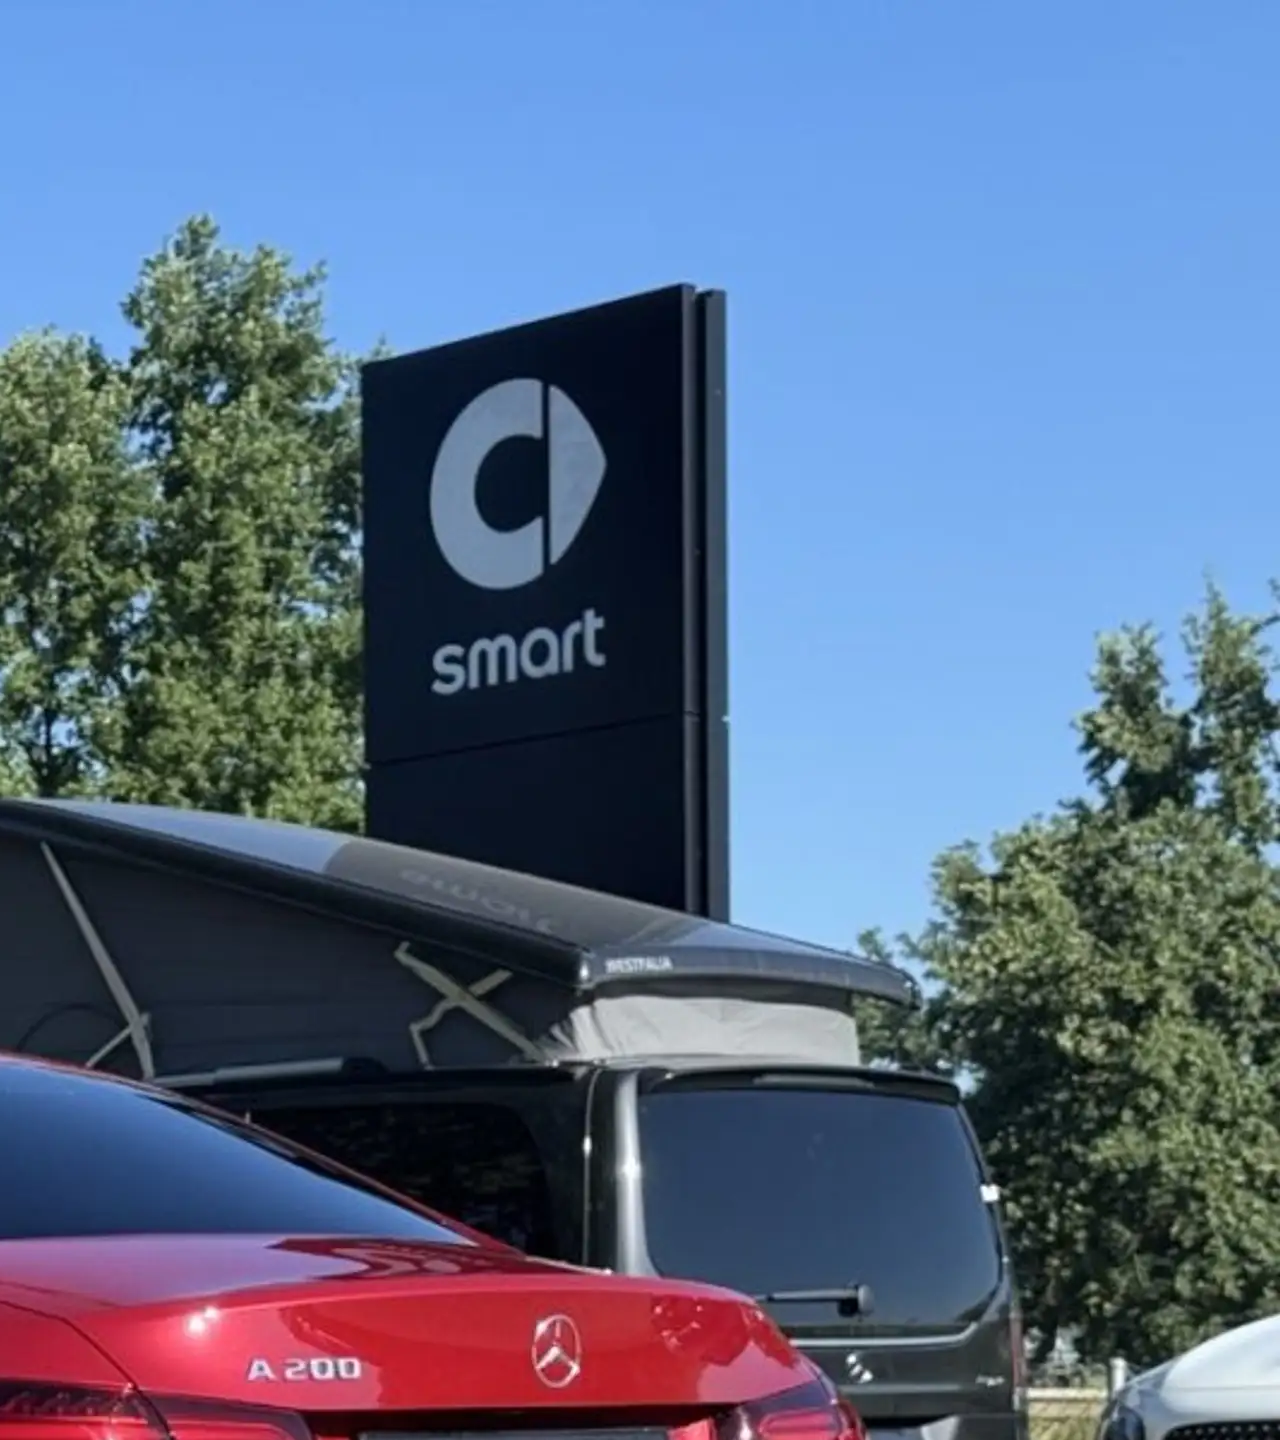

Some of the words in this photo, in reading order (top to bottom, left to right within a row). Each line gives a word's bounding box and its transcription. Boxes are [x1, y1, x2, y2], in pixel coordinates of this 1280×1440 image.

[431, 608, 606, 695] smart
[246, 1357, 277, 1381] A
[284, 1356, 362, 1380] 200
